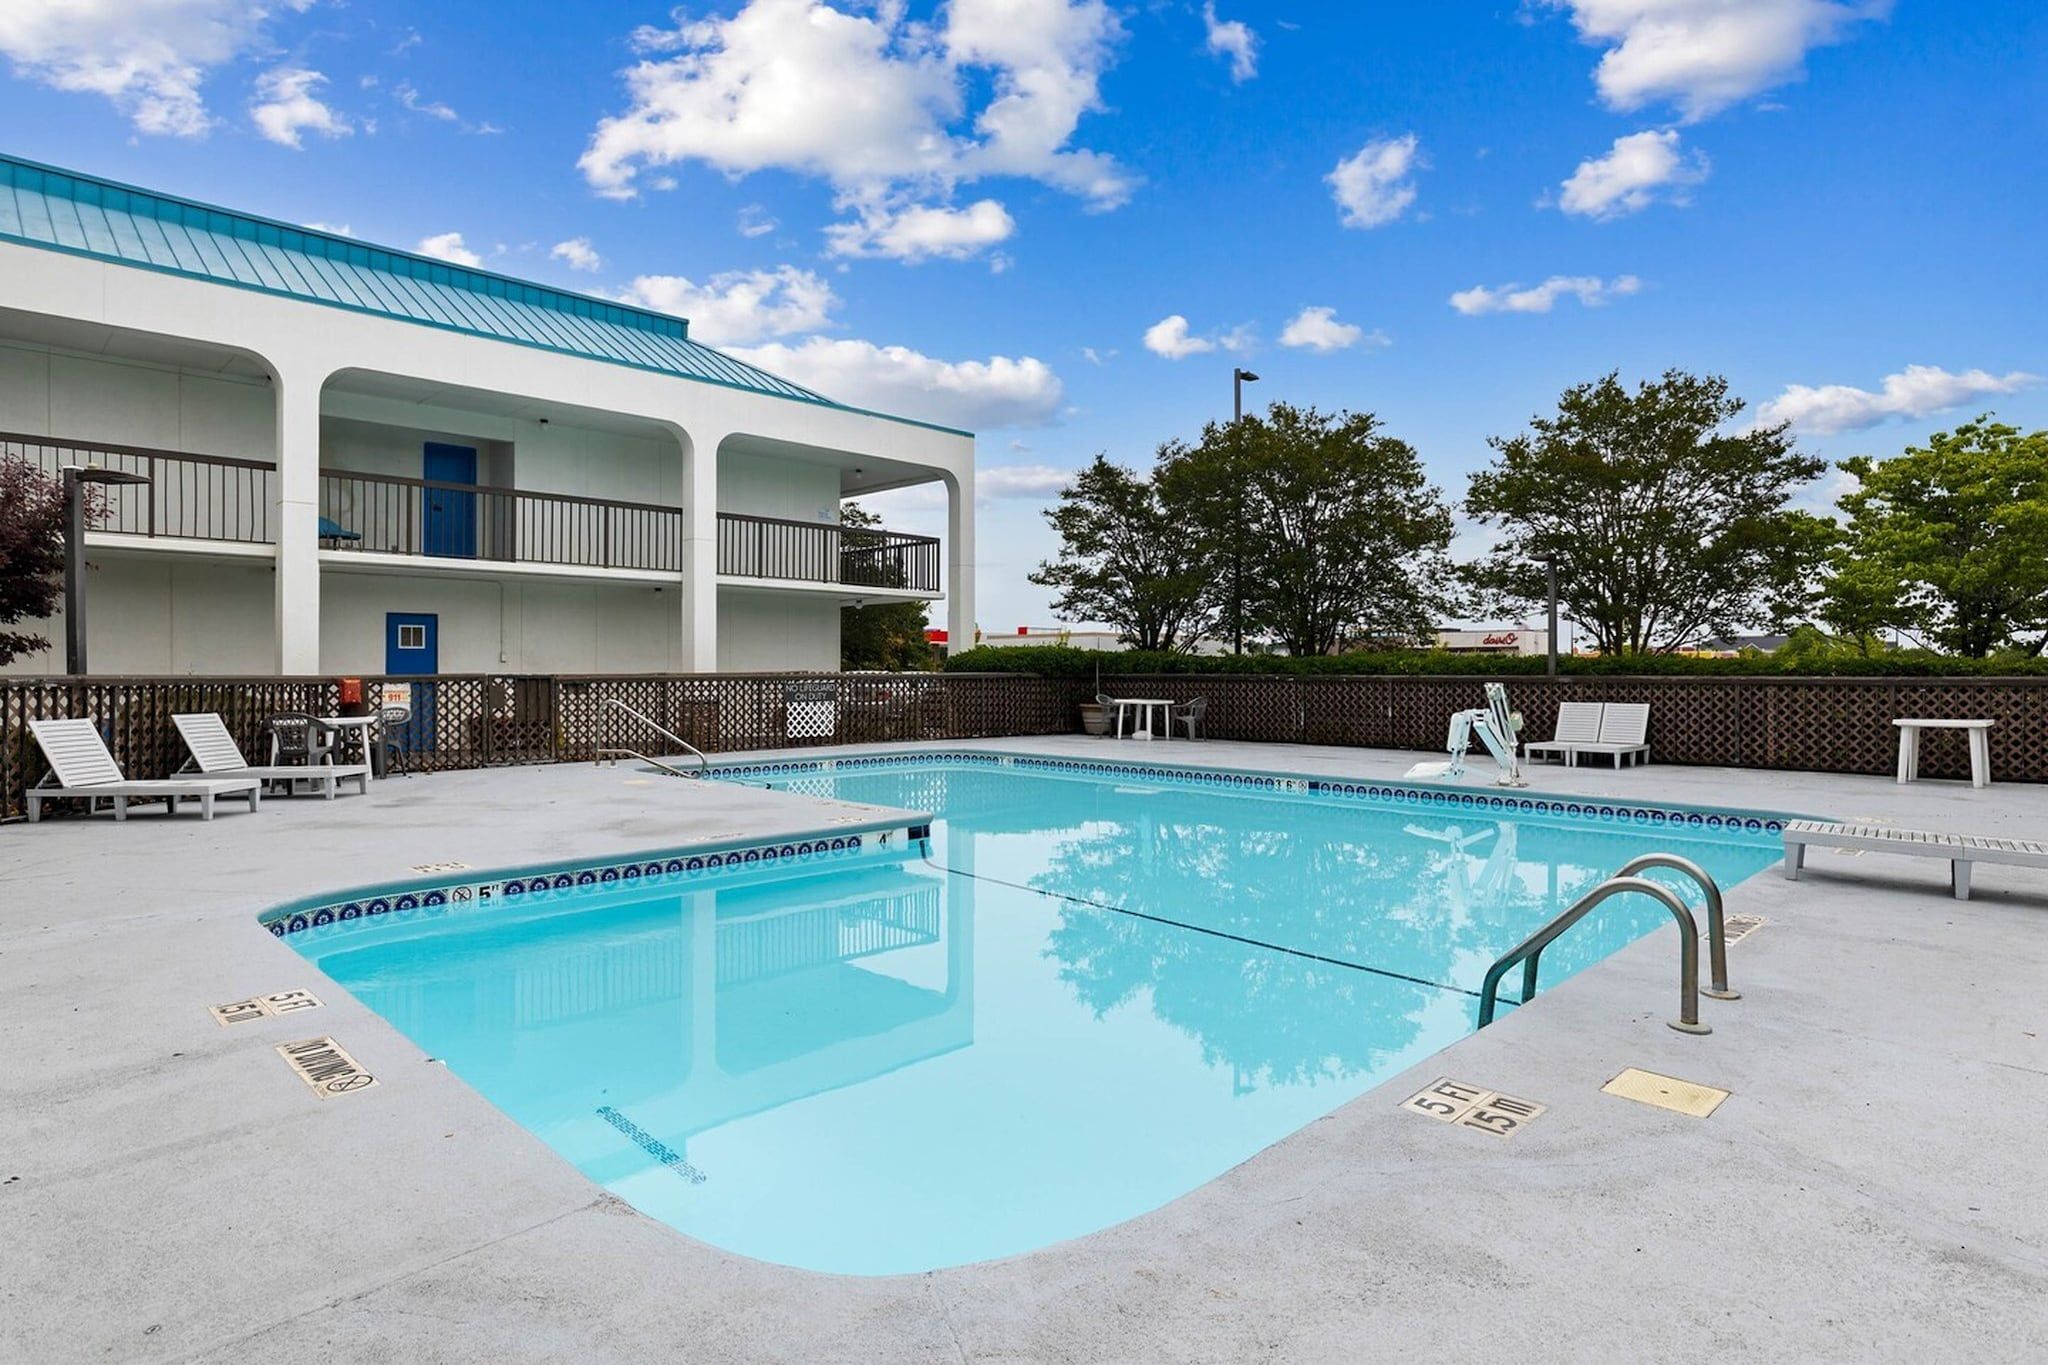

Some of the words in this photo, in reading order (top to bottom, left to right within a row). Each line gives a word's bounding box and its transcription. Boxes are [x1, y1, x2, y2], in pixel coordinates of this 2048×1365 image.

[795, 692, 807, 701] ON
[294, 1048, 357, 1083] DIVING
[1432, 1081, 1480, 1102] FT
